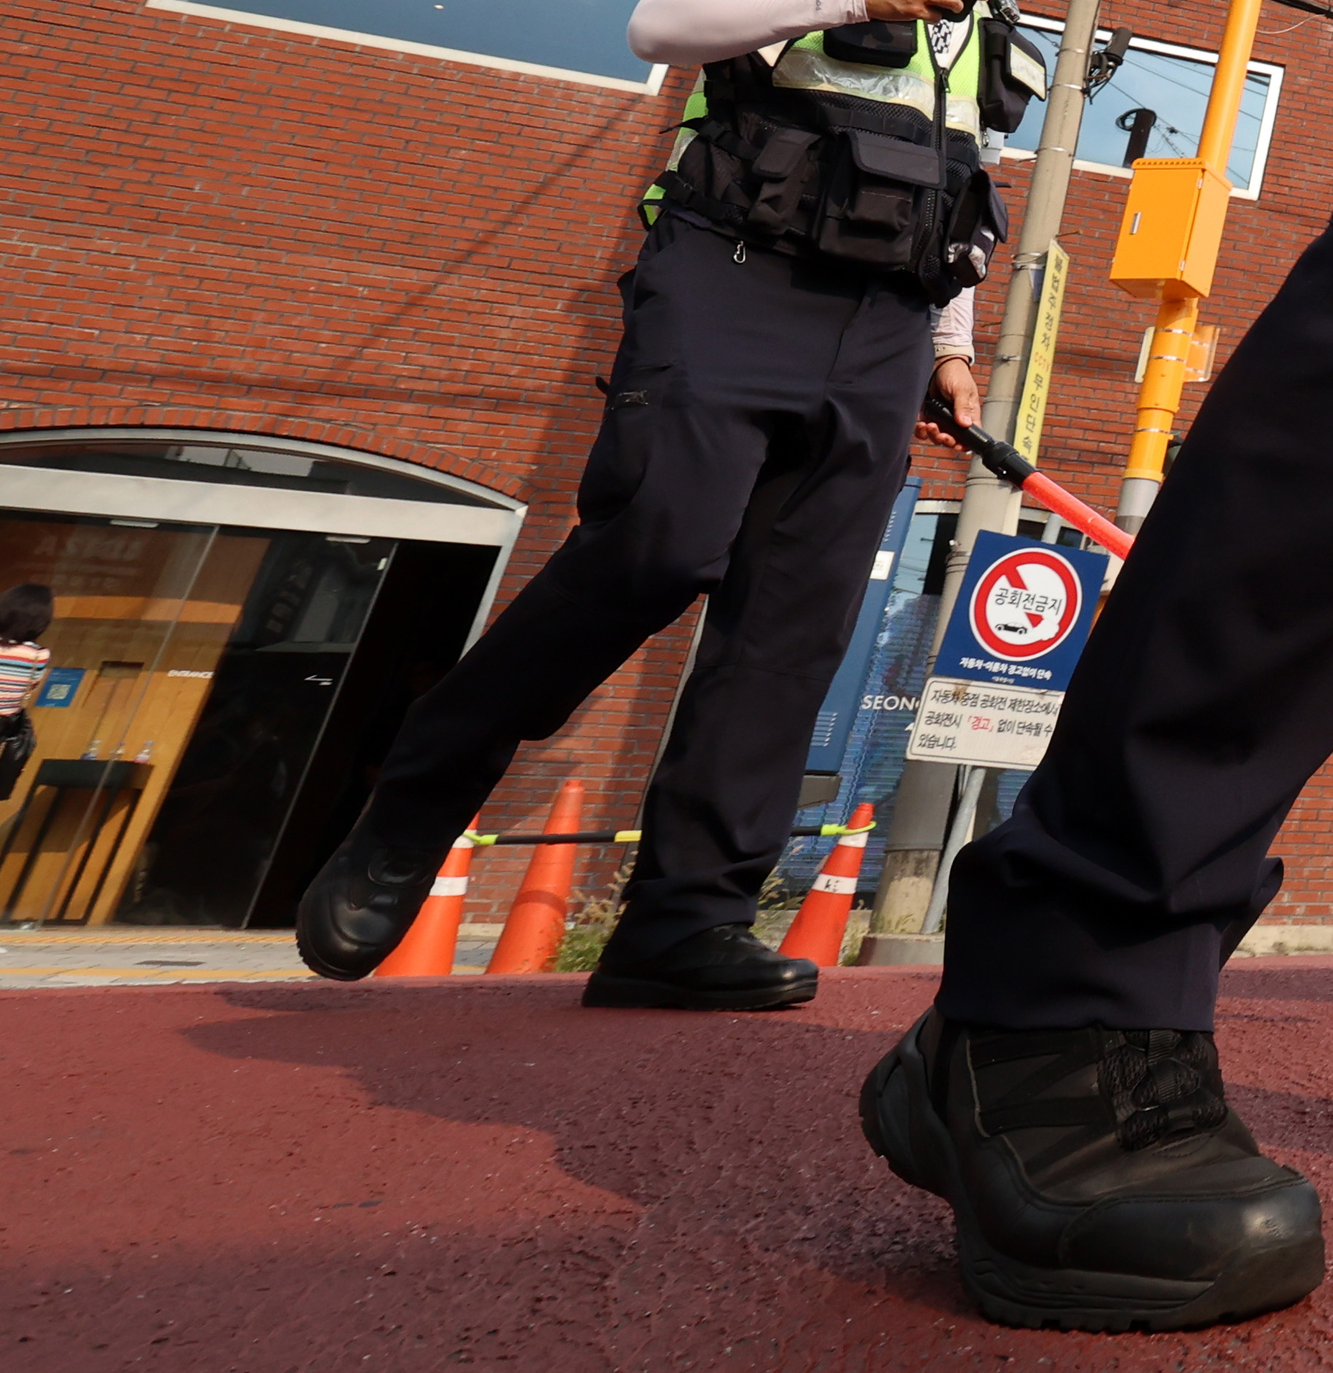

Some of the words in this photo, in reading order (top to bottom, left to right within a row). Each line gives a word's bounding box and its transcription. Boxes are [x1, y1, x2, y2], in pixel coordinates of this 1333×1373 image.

[994, 588, 1063, 616] 공회전금지
[930, 690, 960, 704] 자동차
[980, 695, 1007, 710] 공회전
[924, 710, 963, 728] 공회전시
[997, 719, 1016, 734] 없이
[1044, 724, 1053, 738] 수
